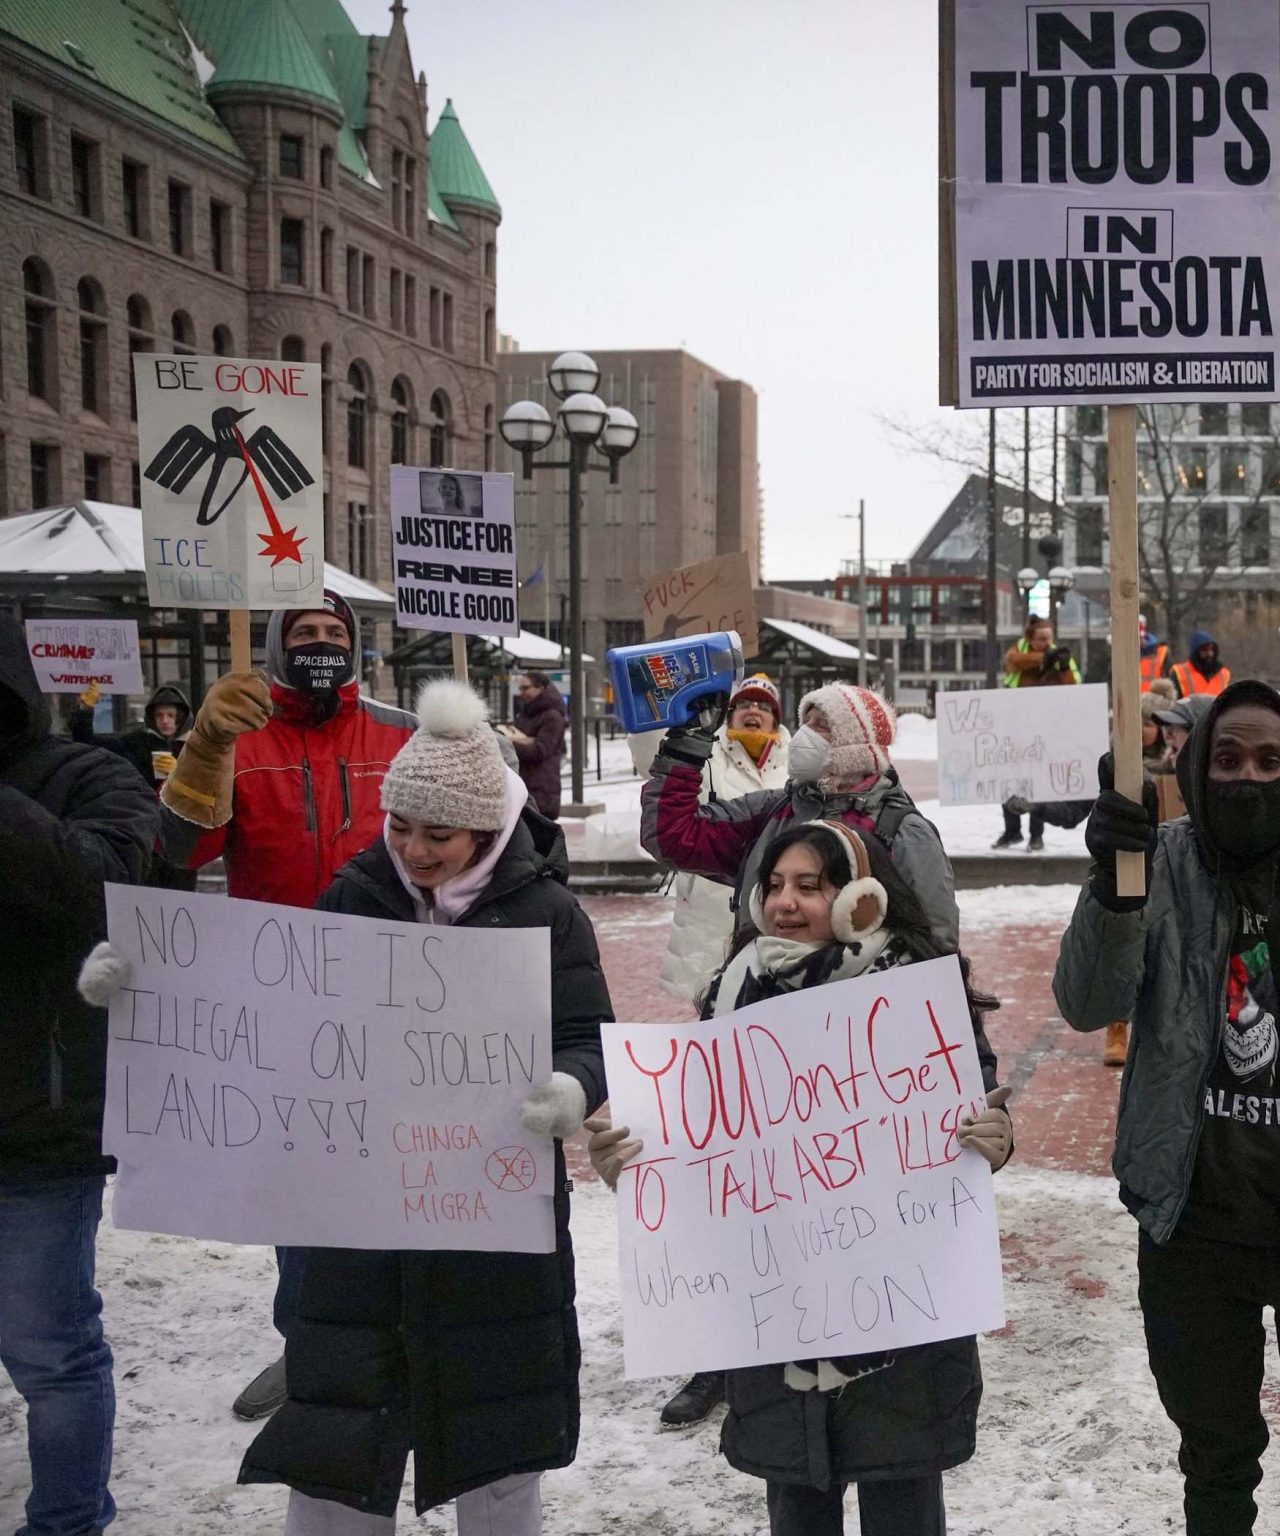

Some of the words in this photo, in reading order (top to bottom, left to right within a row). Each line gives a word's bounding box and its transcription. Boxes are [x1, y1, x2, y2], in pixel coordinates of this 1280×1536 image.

[1036, 10, 1206, 70] NO
[970, 71, 1271, 186] TROOPS
[1083, 215, 1157, 254] IN
[971, 256, 1273, 341] MINNESOTA
[155, 360, 203, 391] BE
[215, 364, 308, 396] GONE
[975, 363, 1028, 390] PARTY
[1030, 363, 1062, 389] FOR
[1064, 362, 1150, 389] SOCIALISM
[1153, 363, 1174, 384] &
[1177, 360, 1268, 384] LIBERATION
[153, 538, 213, 567] ICE
[396, 516, 473, 551] JUSTICE
[475, 522, 513, 554] FOR
[157, 571, 244, 601] HOLES
[397, 559, 513, 588] RENEE
[398, 587, 461, 619] NICOLE
[464, 593, 514, 623] GOOD
[644, 570, 695, 617] FUCK
[707, 609, 747, 636] ICE
[294, 655, 346, 666] SPACEBALLS
[310, 669, 320, 677] THE
[321, 669, 333, 677] FACE
[646, 655, 675, 690] MELT
[661, 655, 681, 674] ICE
[688, 652, 700, 674] SPLASH
[312, 679, 331, 688] MASK
[945, 698, 994, 735] We
[974, 732, 1046, 768] Protect
[976, 780, 996, 800] OUT
[136, 906, 197, 968] NO
[253, 918, 342, 997] ONE
[376, 932, 446, 1013] IS
[114, 987, 277, 1071] ILLEGAL
[310, 1020, 367, 1081] ON
[403, 1030, 535, 1087] STOLEN
[624, 1026, 760, 1150] YOU
[867, 996, 963, 1105] Get
[393, 1122, 483, 1154] CHINGA
[402, 1161, 439, 1189] LA
[622, 1157, 677, 1232] TO
[687, 1149, 793, 1218] TALK
[791, 1119, 870, 1203] ABT
[403, 1190, 492, 1223] MIGRA
[633, 1241, 729, 1308] When
[951, 1176, 983, 1228] A
[749, 1264, 940, 1351] FELON
